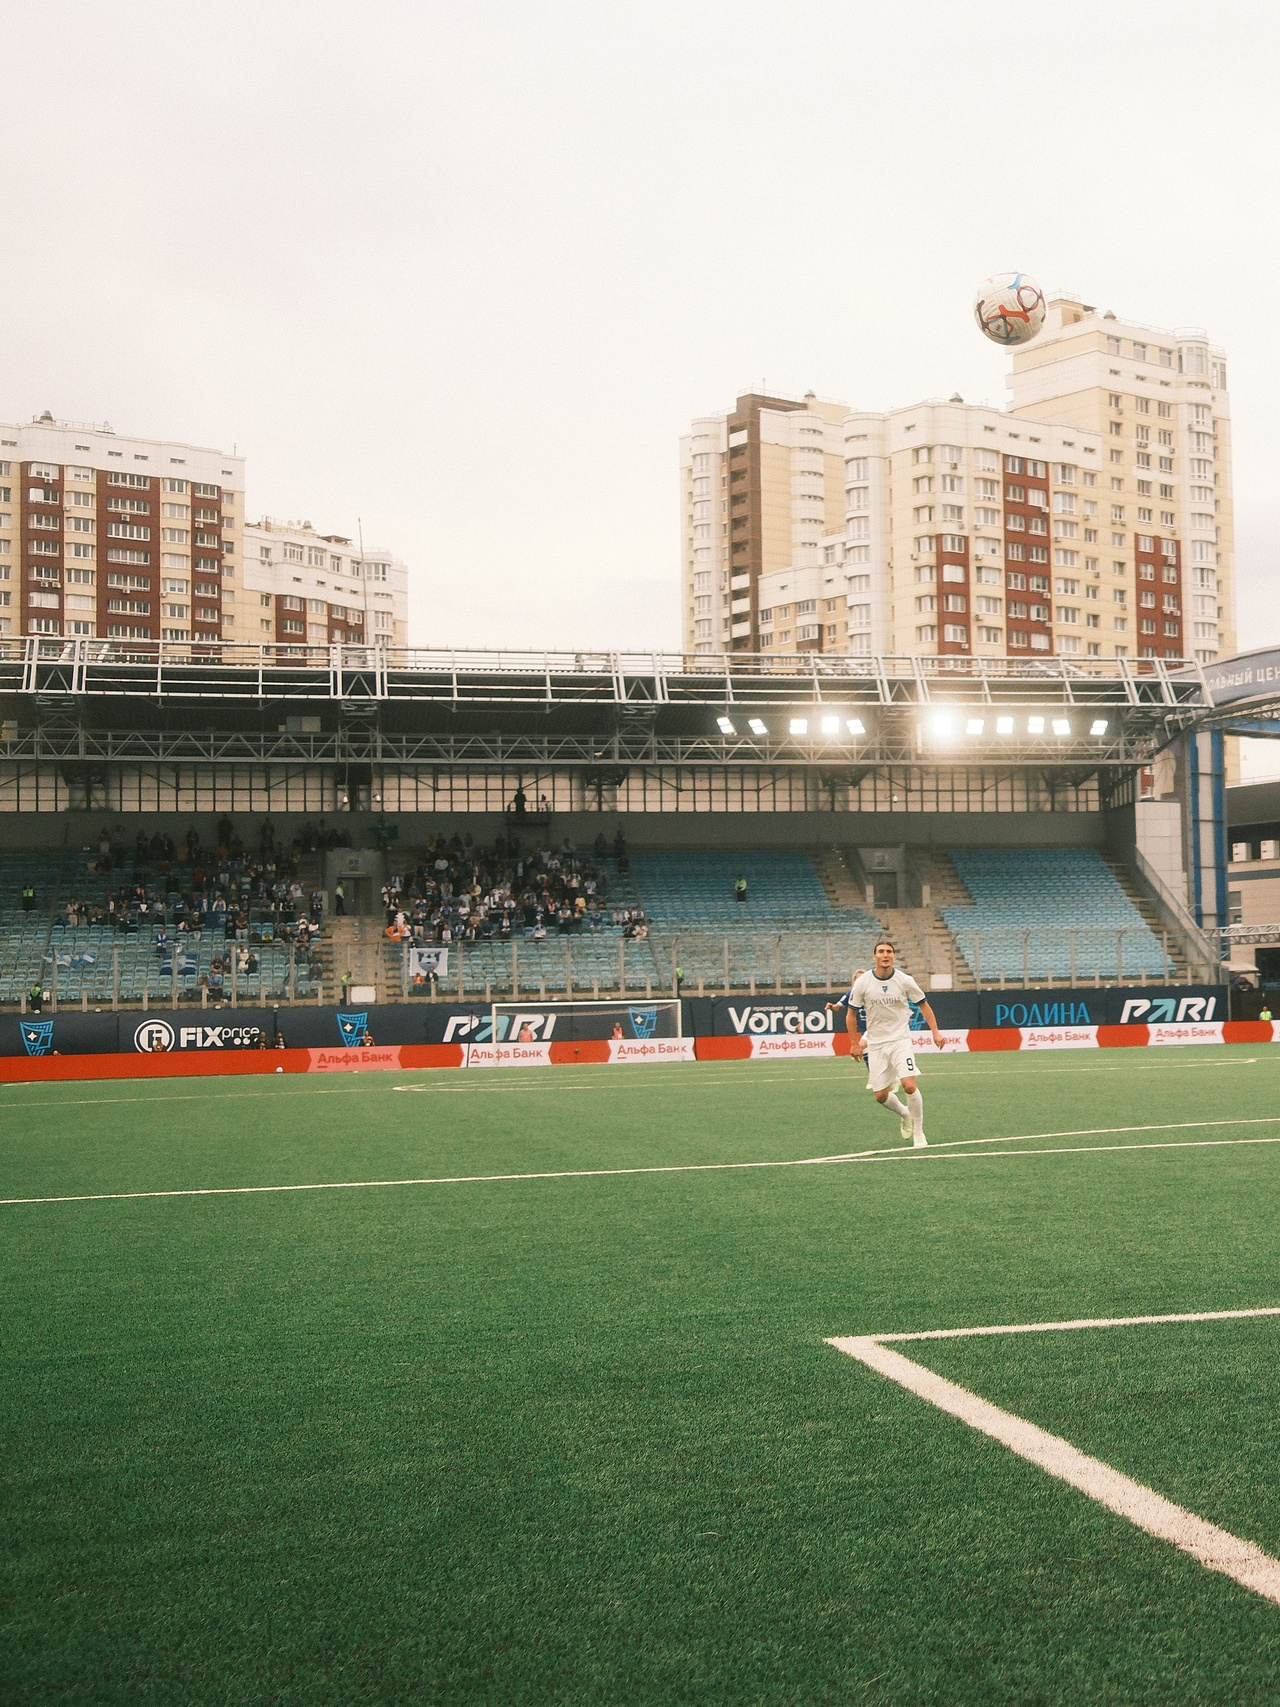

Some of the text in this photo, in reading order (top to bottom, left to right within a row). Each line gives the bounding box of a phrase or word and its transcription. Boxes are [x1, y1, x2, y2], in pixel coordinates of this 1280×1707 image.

[1207, 667, 1252, 692] ОЛЬНЫЙ
[995, 1002, 1091, 1027] РОДИНА
[1119, 996, 1216, 1024] PARI
[728, 1006, 833, 1034] Vorgol
[222, 1026, 260, 1040] price
[442, 1013, 557, 1043] PARI
[1156, 1027, 1216, 1039] Альфа Банк
[911, 1035, 932, 1047] ьфа
[1028, 1031, 1091, 1043] Альфа Банк
[617, 1043, 687, 1056] Альфа Банк
[759, 1039, 827, 1052] Альфа Банк
[317, 1051, 393, 1066] Альфа Банк
[470, 1047, 543, 1062] Альфа Банк
[906, 1057, 914, 1071] 9
